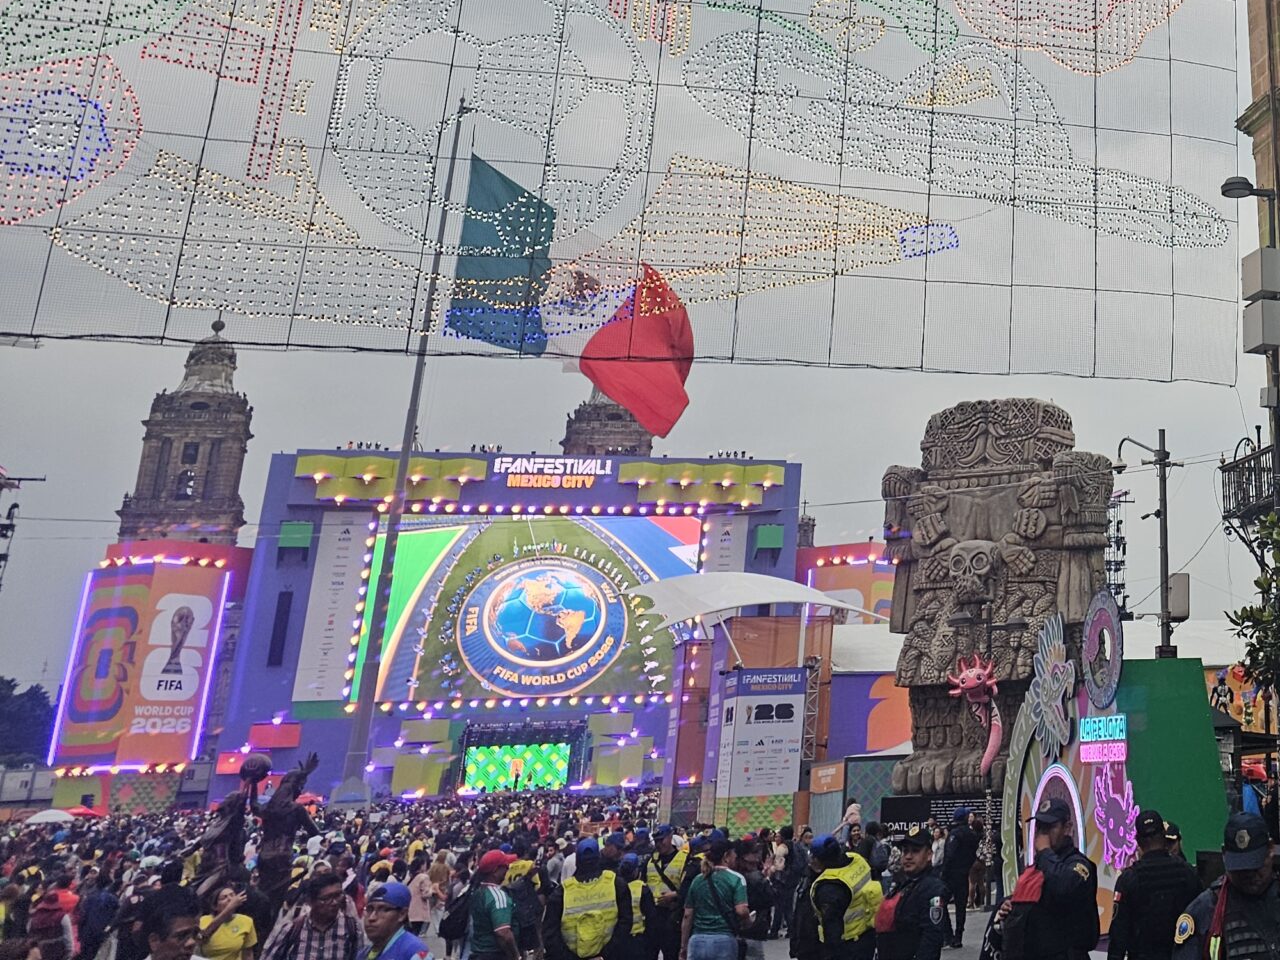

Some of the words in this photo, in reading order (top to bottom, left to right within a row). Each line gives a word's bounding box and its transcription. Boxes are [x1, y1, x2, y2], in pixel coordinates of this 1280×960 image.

[507, 475, 561, 488] MEXICO
[562, 476, 594, 488] CITY
[466, 606, 480, 636] FIFA
[493, 666, 519, 683] FIFA
[521, 672, 566, 686] WORLD
[567, 664, 588, 679] CUP
[588, 635, 615, 668] 2026
[157, 680, 183, 691] FIFA
[134, 705, 173, 716] WORLD
[173, 705, 194, 716] CUP
[754, 703, 794, 721] 26
[129, 717, 192, 734] 2026
